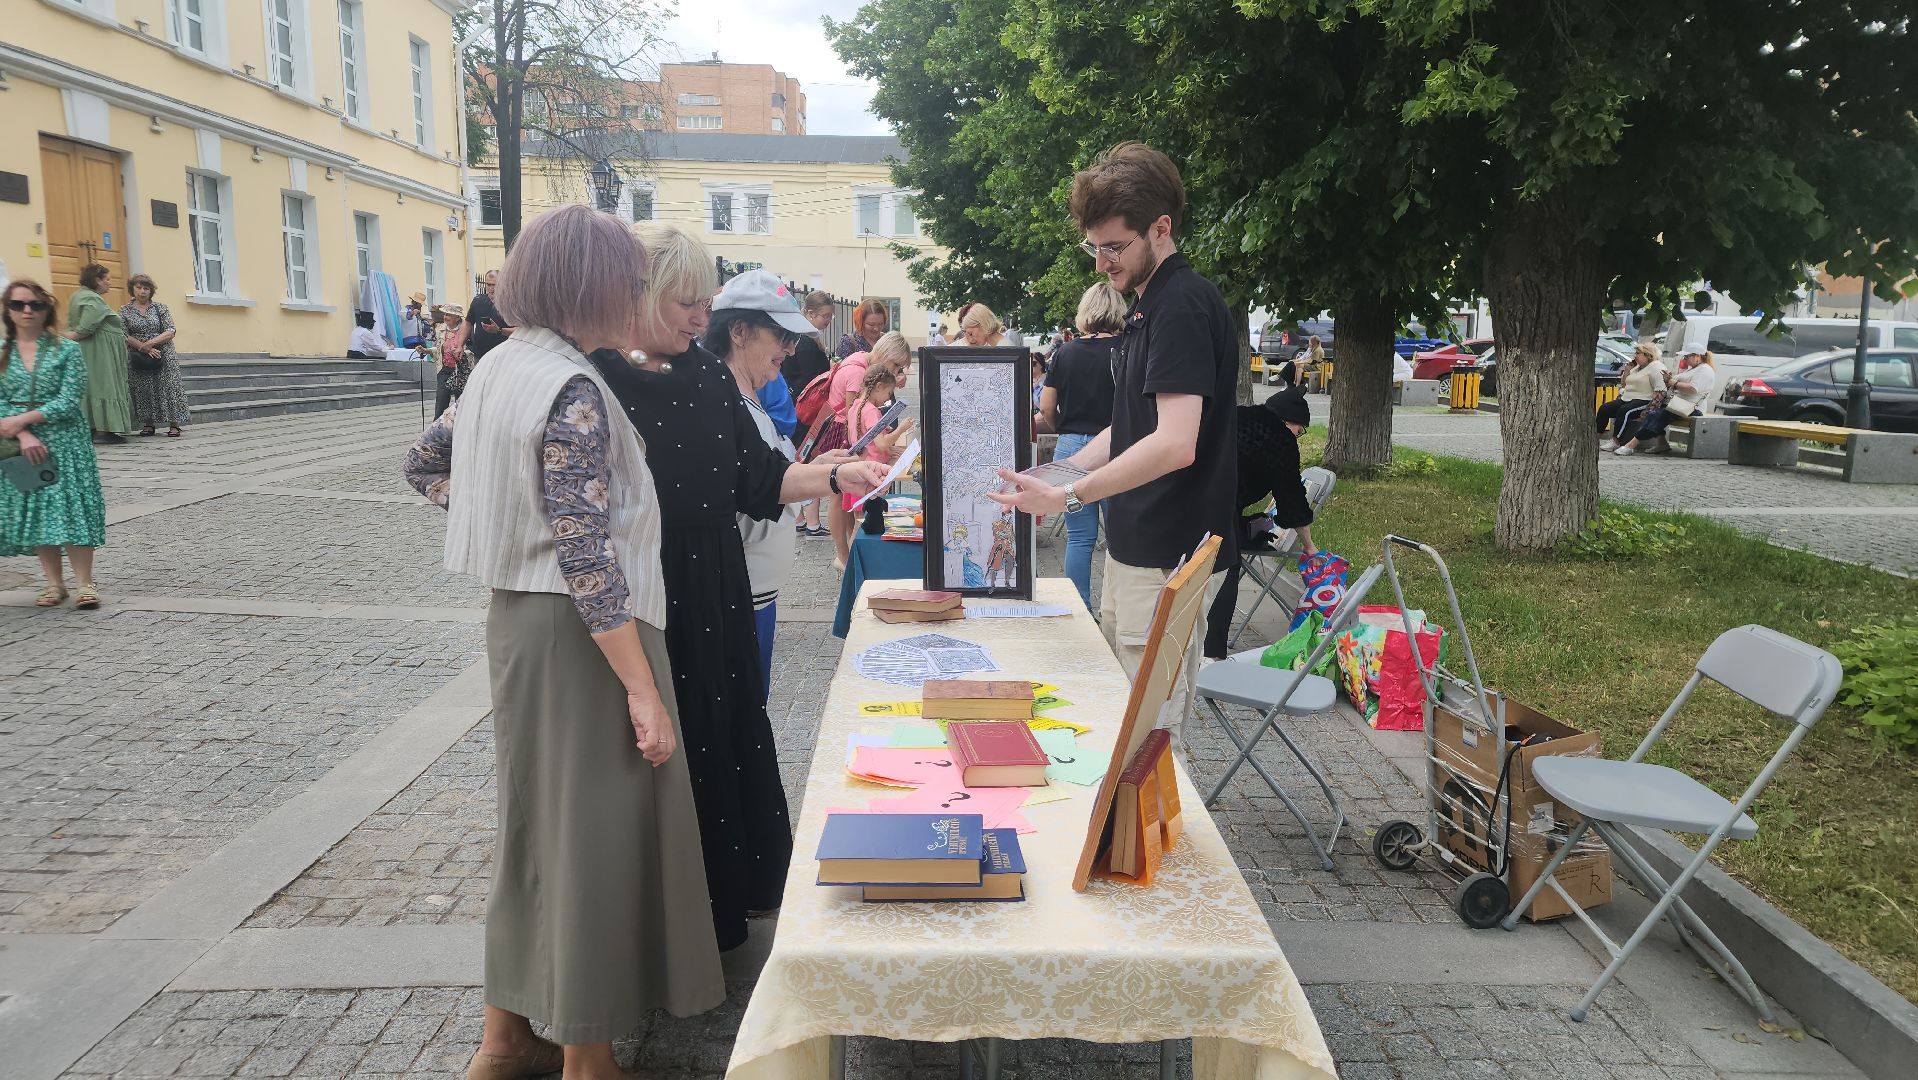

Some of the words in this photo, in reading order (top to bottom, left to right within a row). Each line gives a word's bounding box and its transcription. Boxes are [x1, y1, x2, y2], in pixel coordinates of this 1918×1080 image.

[712, 195, 732, 231] AVON
[914, 759, 953, 768] ?
[940, 791, 971, 808] ?
[1589, 868, 1605, 896] R
